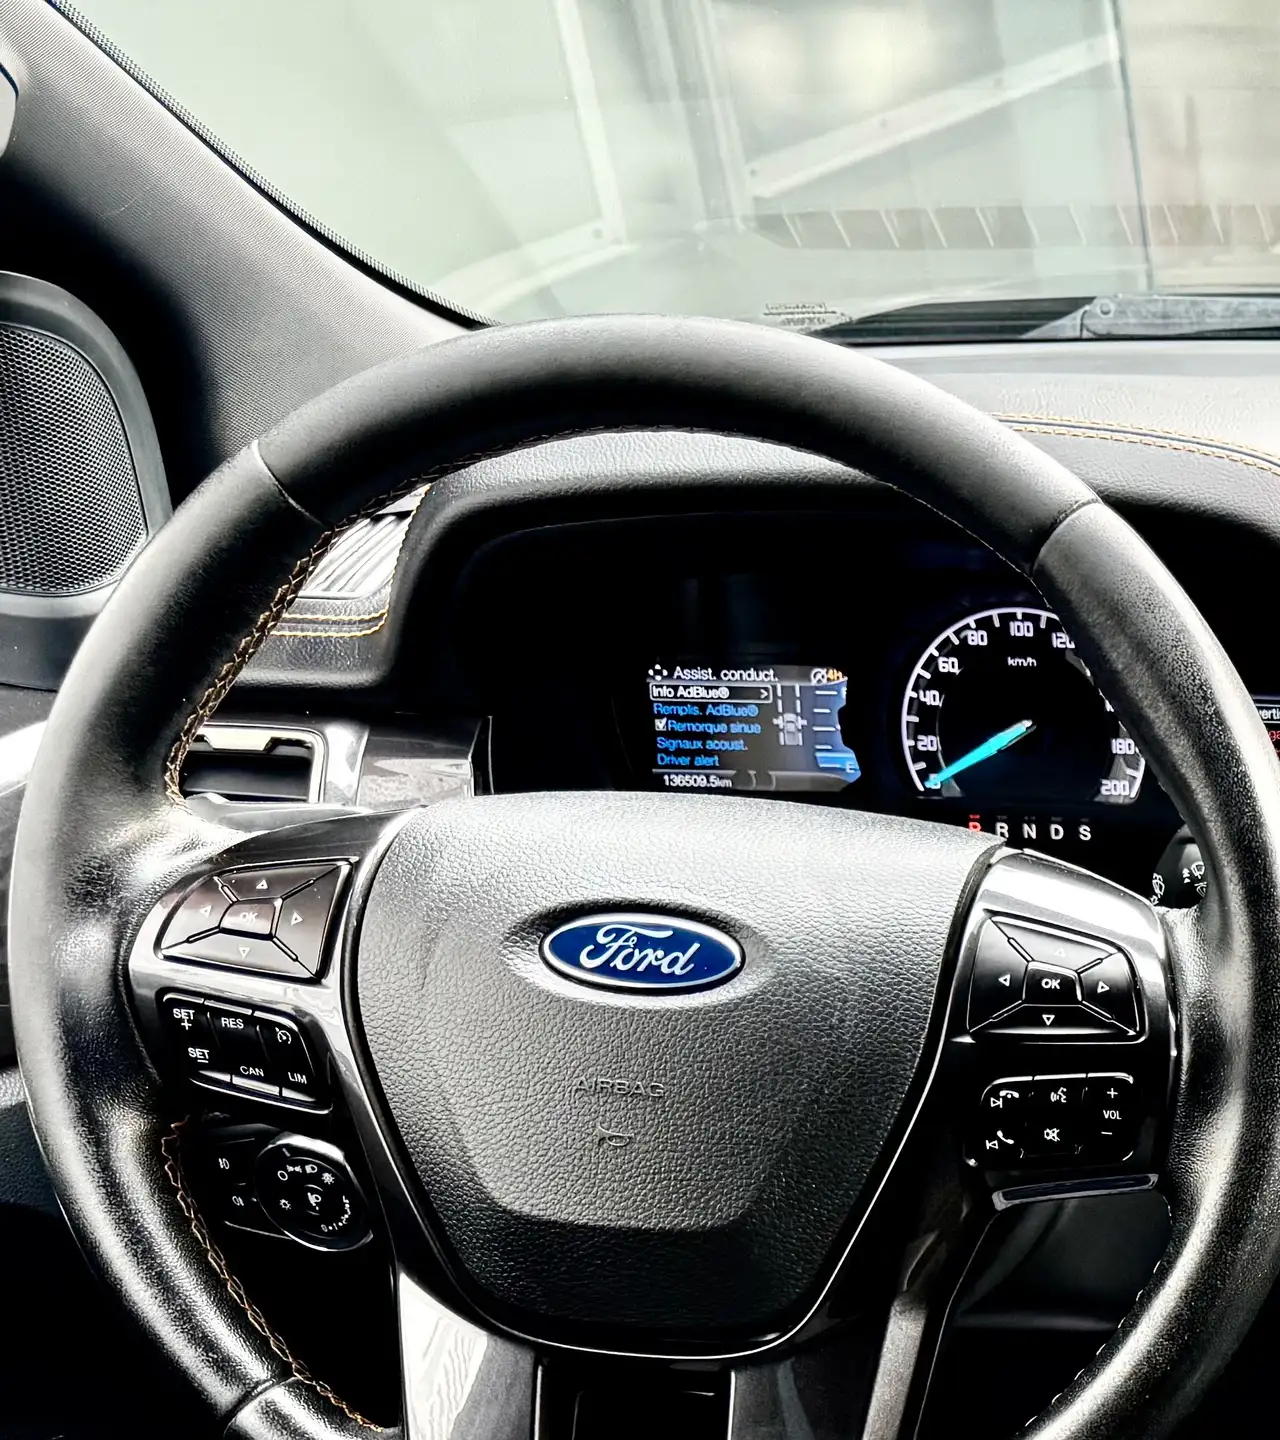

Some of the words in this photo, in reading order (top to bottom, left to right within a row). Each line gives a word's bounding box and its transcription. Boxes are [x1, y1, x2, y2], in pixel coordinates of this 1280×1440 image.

[1009, 621, 1034, 637] 100
[967, 630, 988, 646] 80
[938, 657, 959, 673] 60
[1007, 656, 1037, 667] km/h
[673, 666, 717, 681] Assist.
[720, 667, 779, 682] conduct.
[652, 685, 674, 698] Info
[919, 690, 940, 706] 40
[668, 719, 727, 734] Remorque
[656, 737, 703, 751] Signaux
[917, 735, 937, 751] 20
[1111, 738, 1135, 754] 180
[657, 753, 691, 766] Driver
[694, 754, 720, 767] alert
[1100, 780, 1130, 796] 200
[995, 822, 1009, 838] R
[1023, 823, 1037, 840] N
[1050, 823, 1065, 840] D
[1079, 825, 1092, 841] S
[240, 911, 258, 923] OK
[579, 924, 701, 976] Ford
[1041, 979, 1061, 990] OK
[173, 1008, 195, 1021] SET
[221, 1017, 244, 1030] RES
[188, 1047, 210, 1060] SET
[240, 1065, 265, 1078] CAN
[288, 1071, 308, 1085] LIM
[573, 1075, 666, 1098] AIRBAG
[1103, 1109, 1122, 1120] VOL
